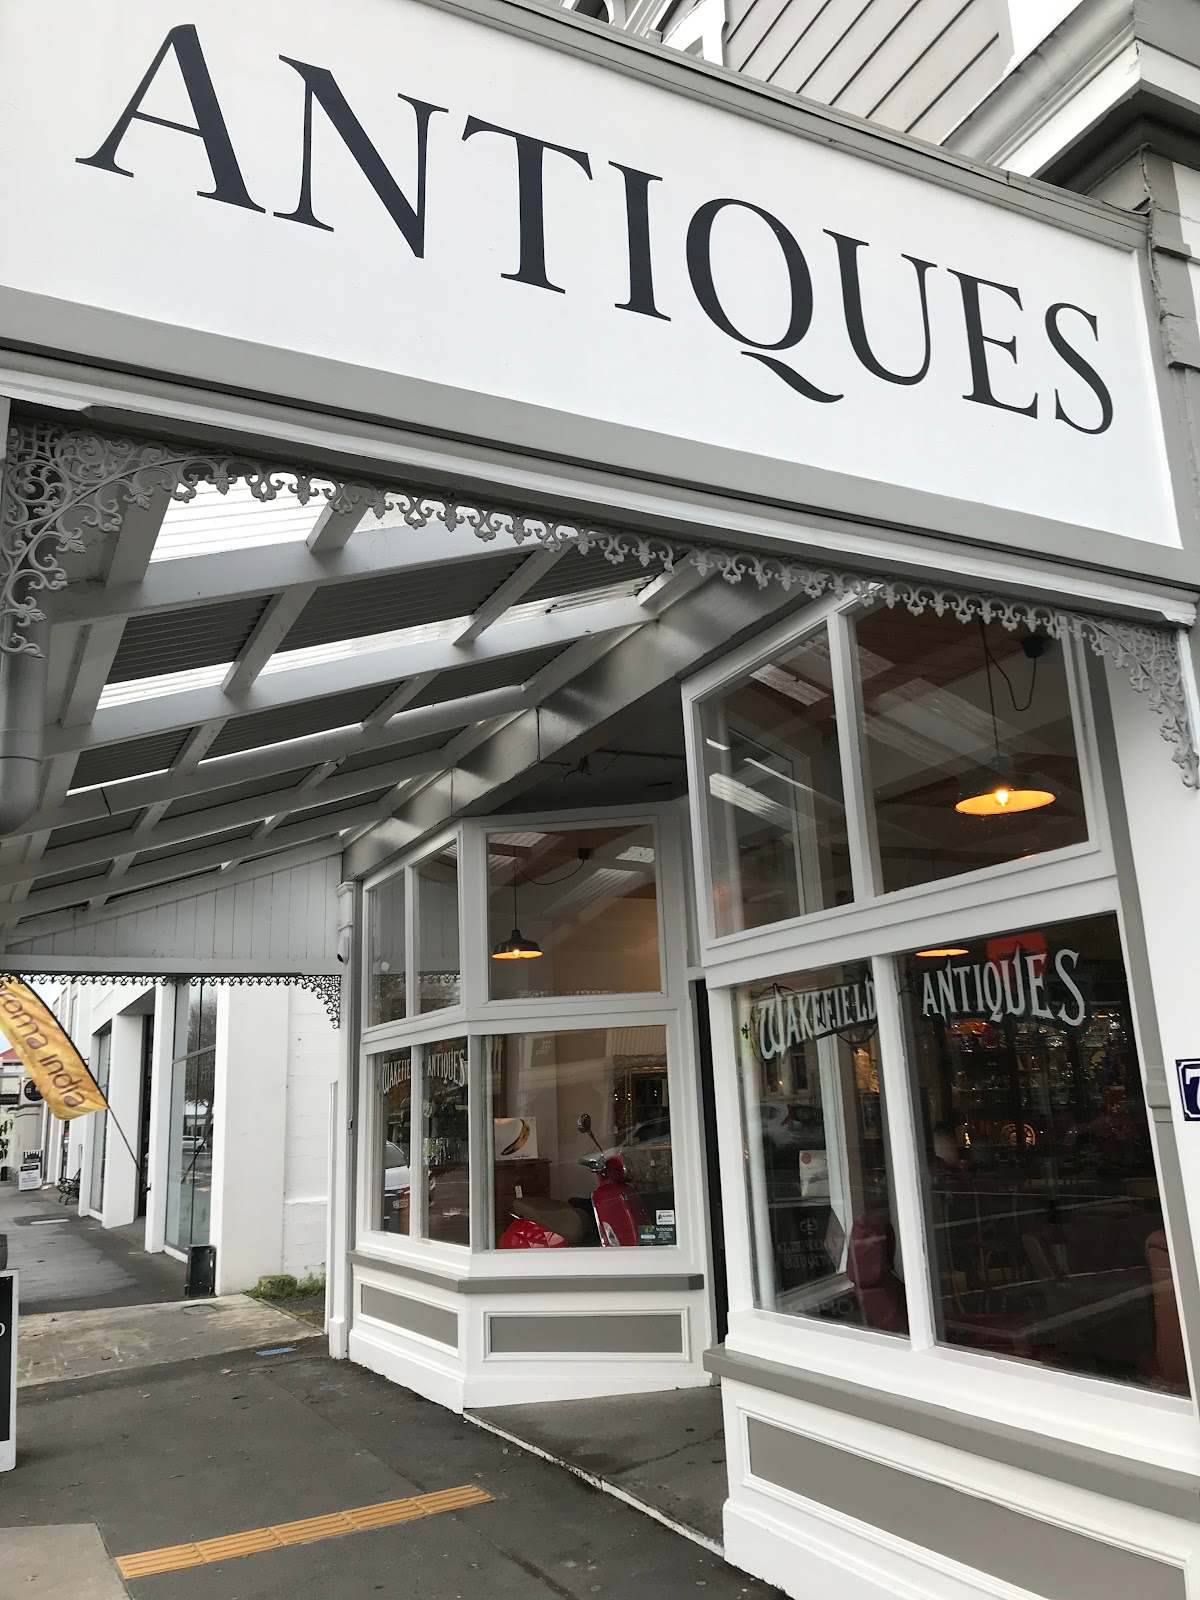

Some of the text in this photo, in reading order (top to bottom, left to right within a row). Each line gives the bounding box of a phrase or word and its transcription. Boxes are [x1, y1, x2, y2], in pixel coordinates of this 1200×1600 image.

[76, 24, 1114, 435] ANTIQUES
[0, 983, 48, 1050] roma
[757, 943, 1086, 1059] WAKEFIELD ANTIQUES
[427, 1047, 466, 1088] ANTIQUES
